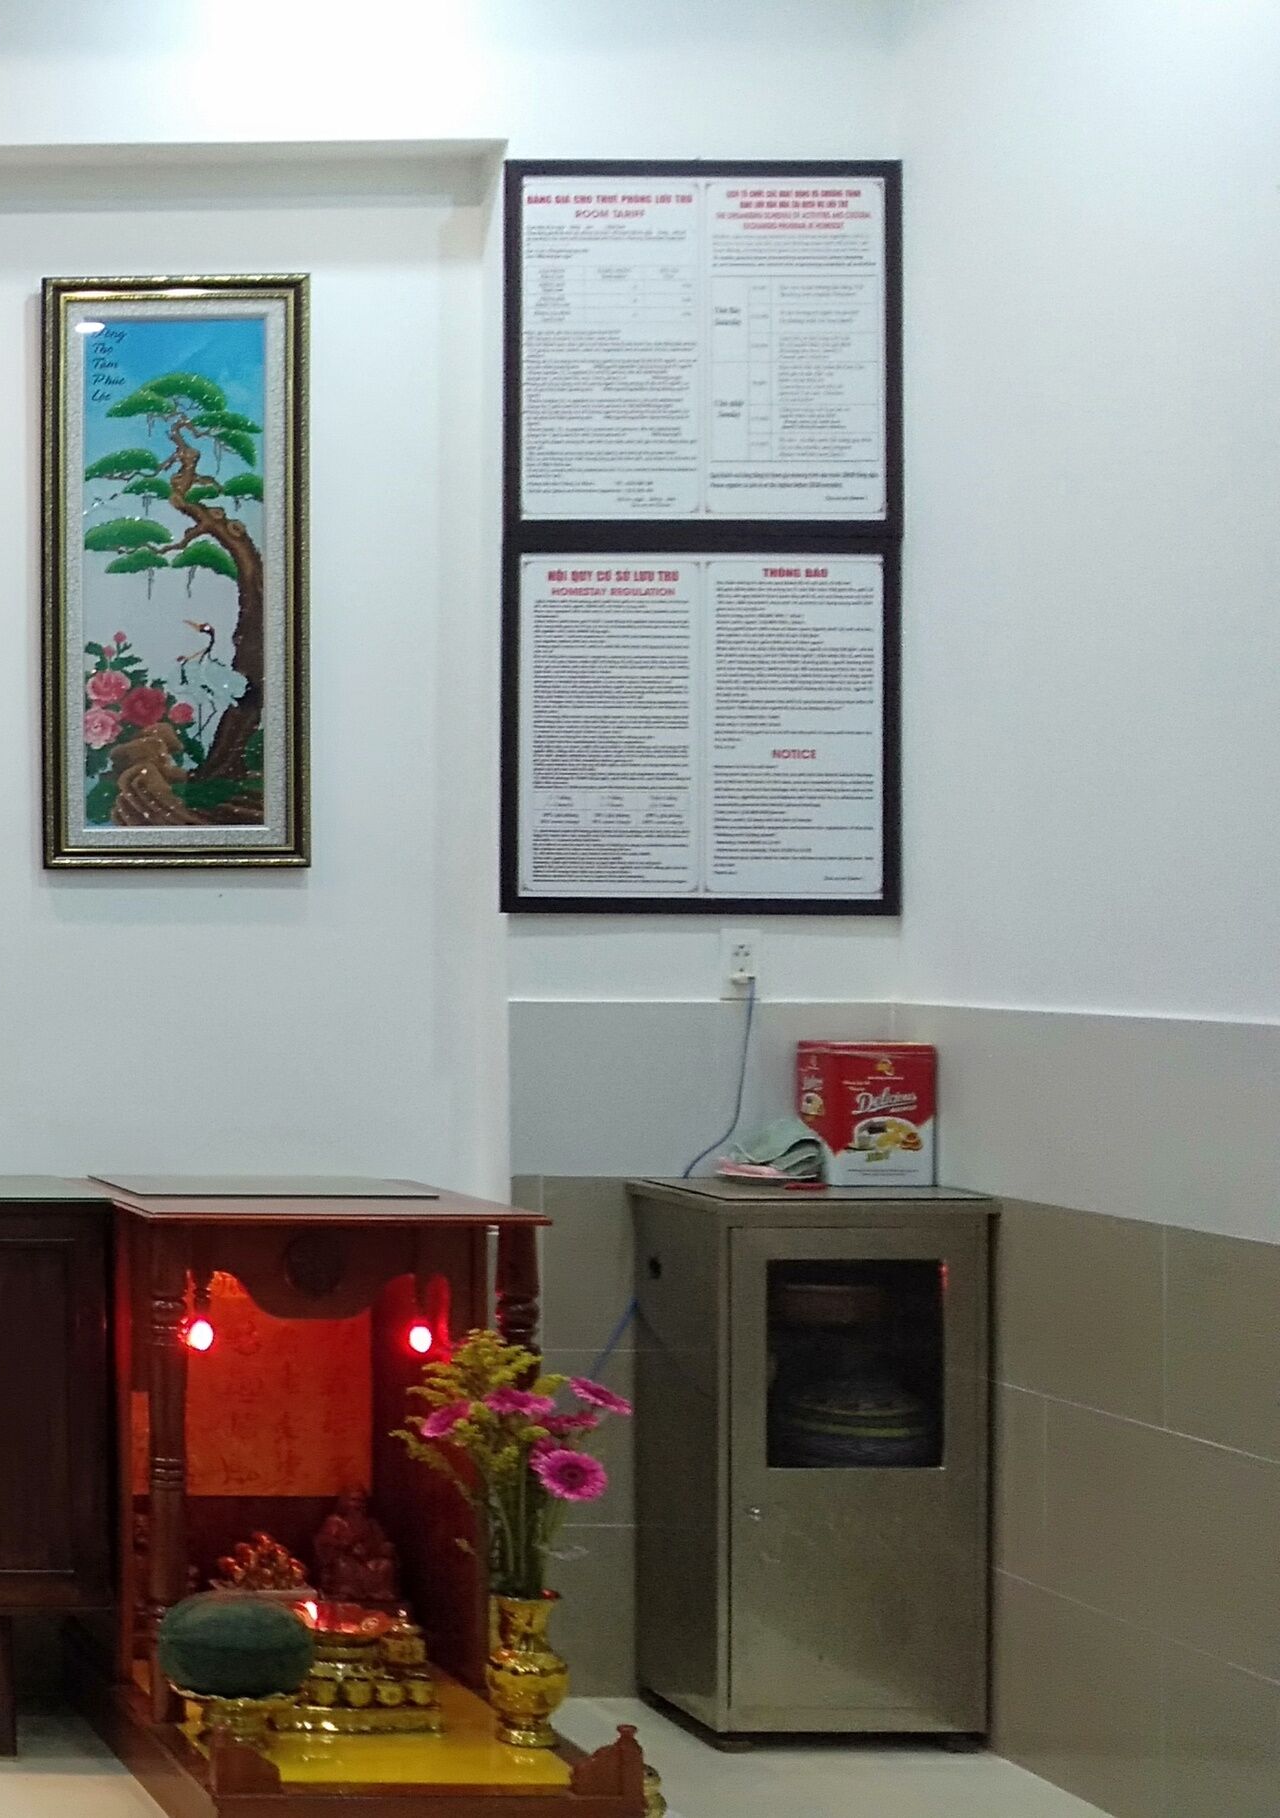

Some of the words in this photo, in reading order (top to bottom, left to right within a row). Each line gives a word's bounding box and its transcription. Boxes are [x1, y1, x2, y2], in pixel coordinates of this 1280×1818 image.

[551, 587, 606, 597] HOMESTAY
[610, 587, 676, 597] REGULATION
[772, 749, 817, 759] NOTICE
